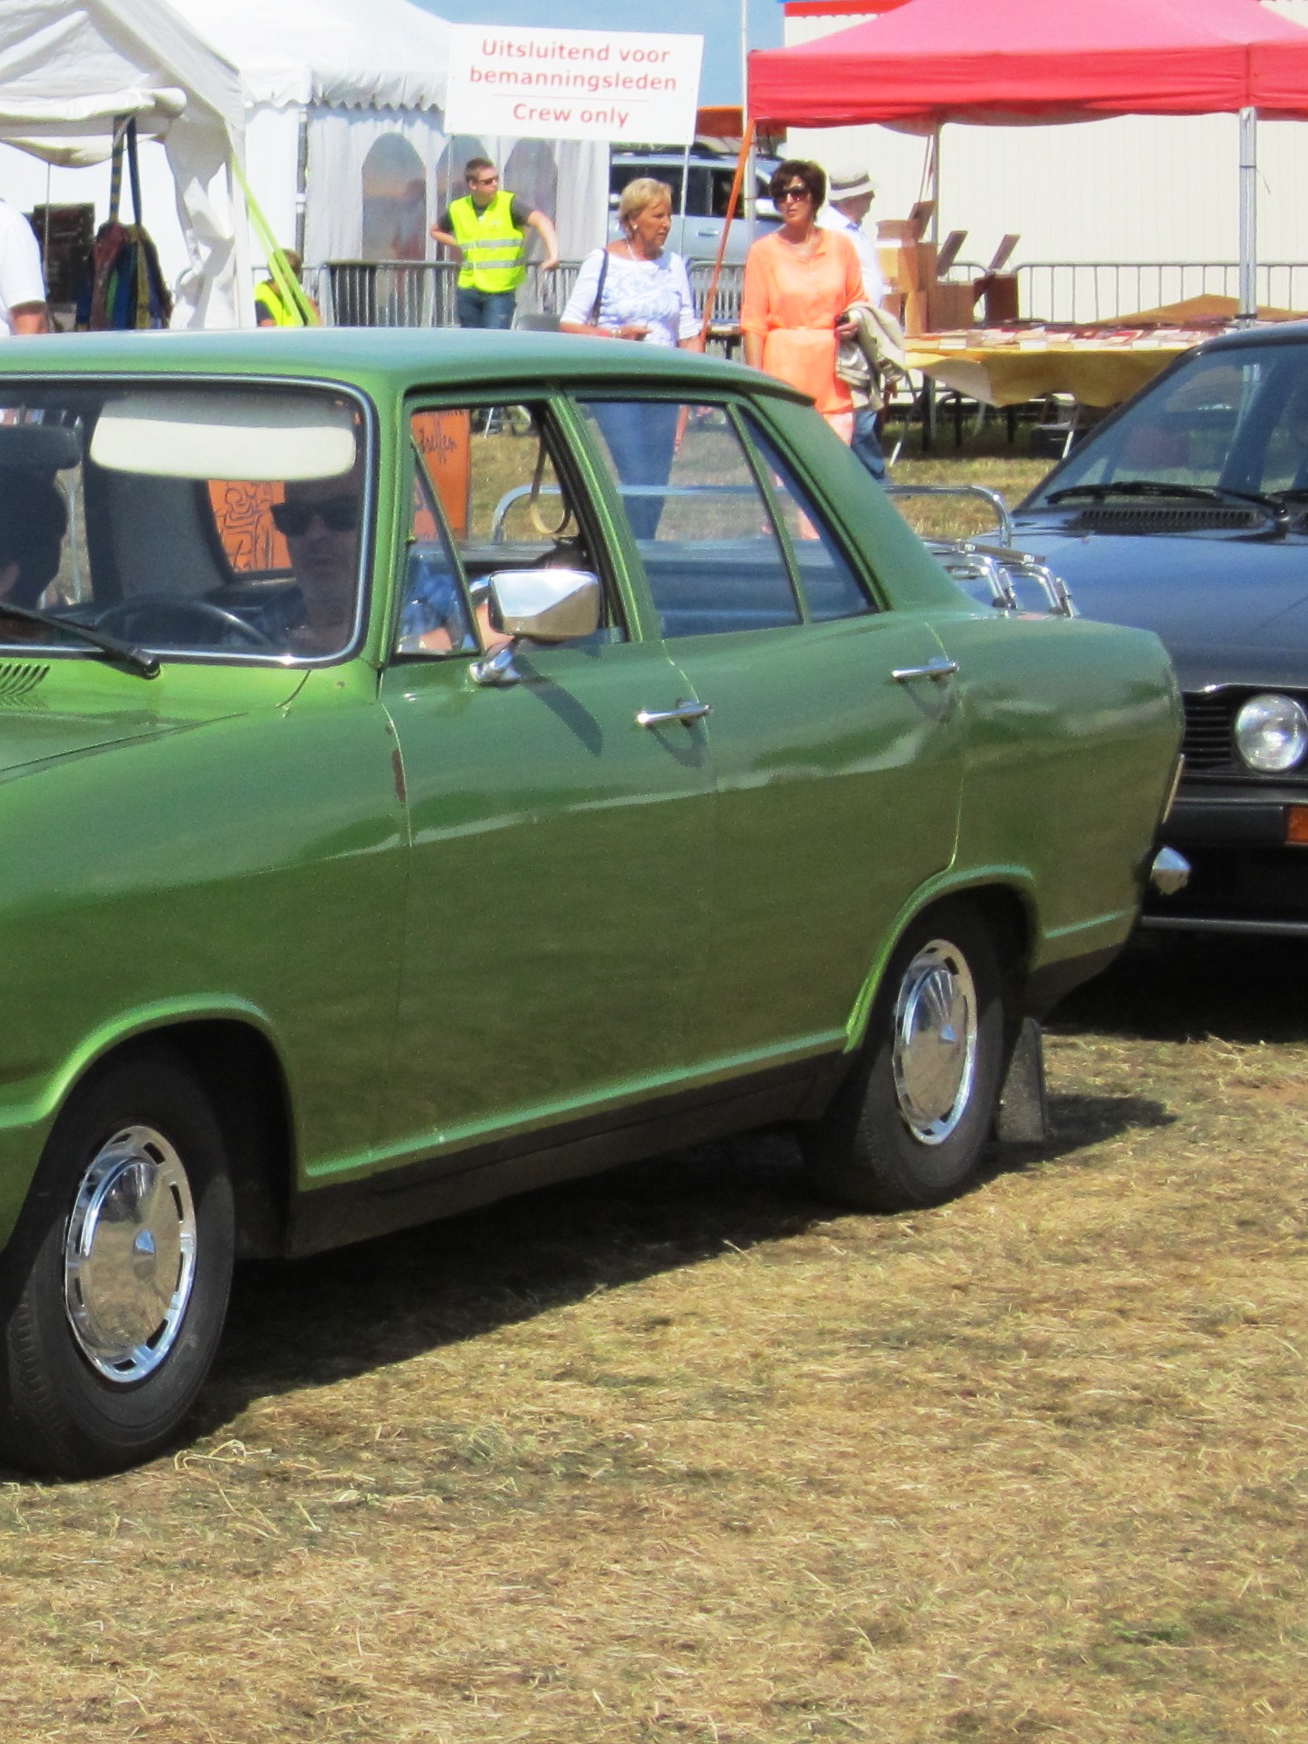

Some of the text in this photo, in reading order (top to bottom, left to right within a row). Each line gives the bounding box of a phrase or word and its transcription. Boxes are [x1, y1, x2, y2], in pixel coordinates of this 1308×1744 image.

[482, 38, 670, 63] Uitsluitend voor
[469, 65, 677, 92] bemanningsleden
[513, 102, 629, 128] Crew only
